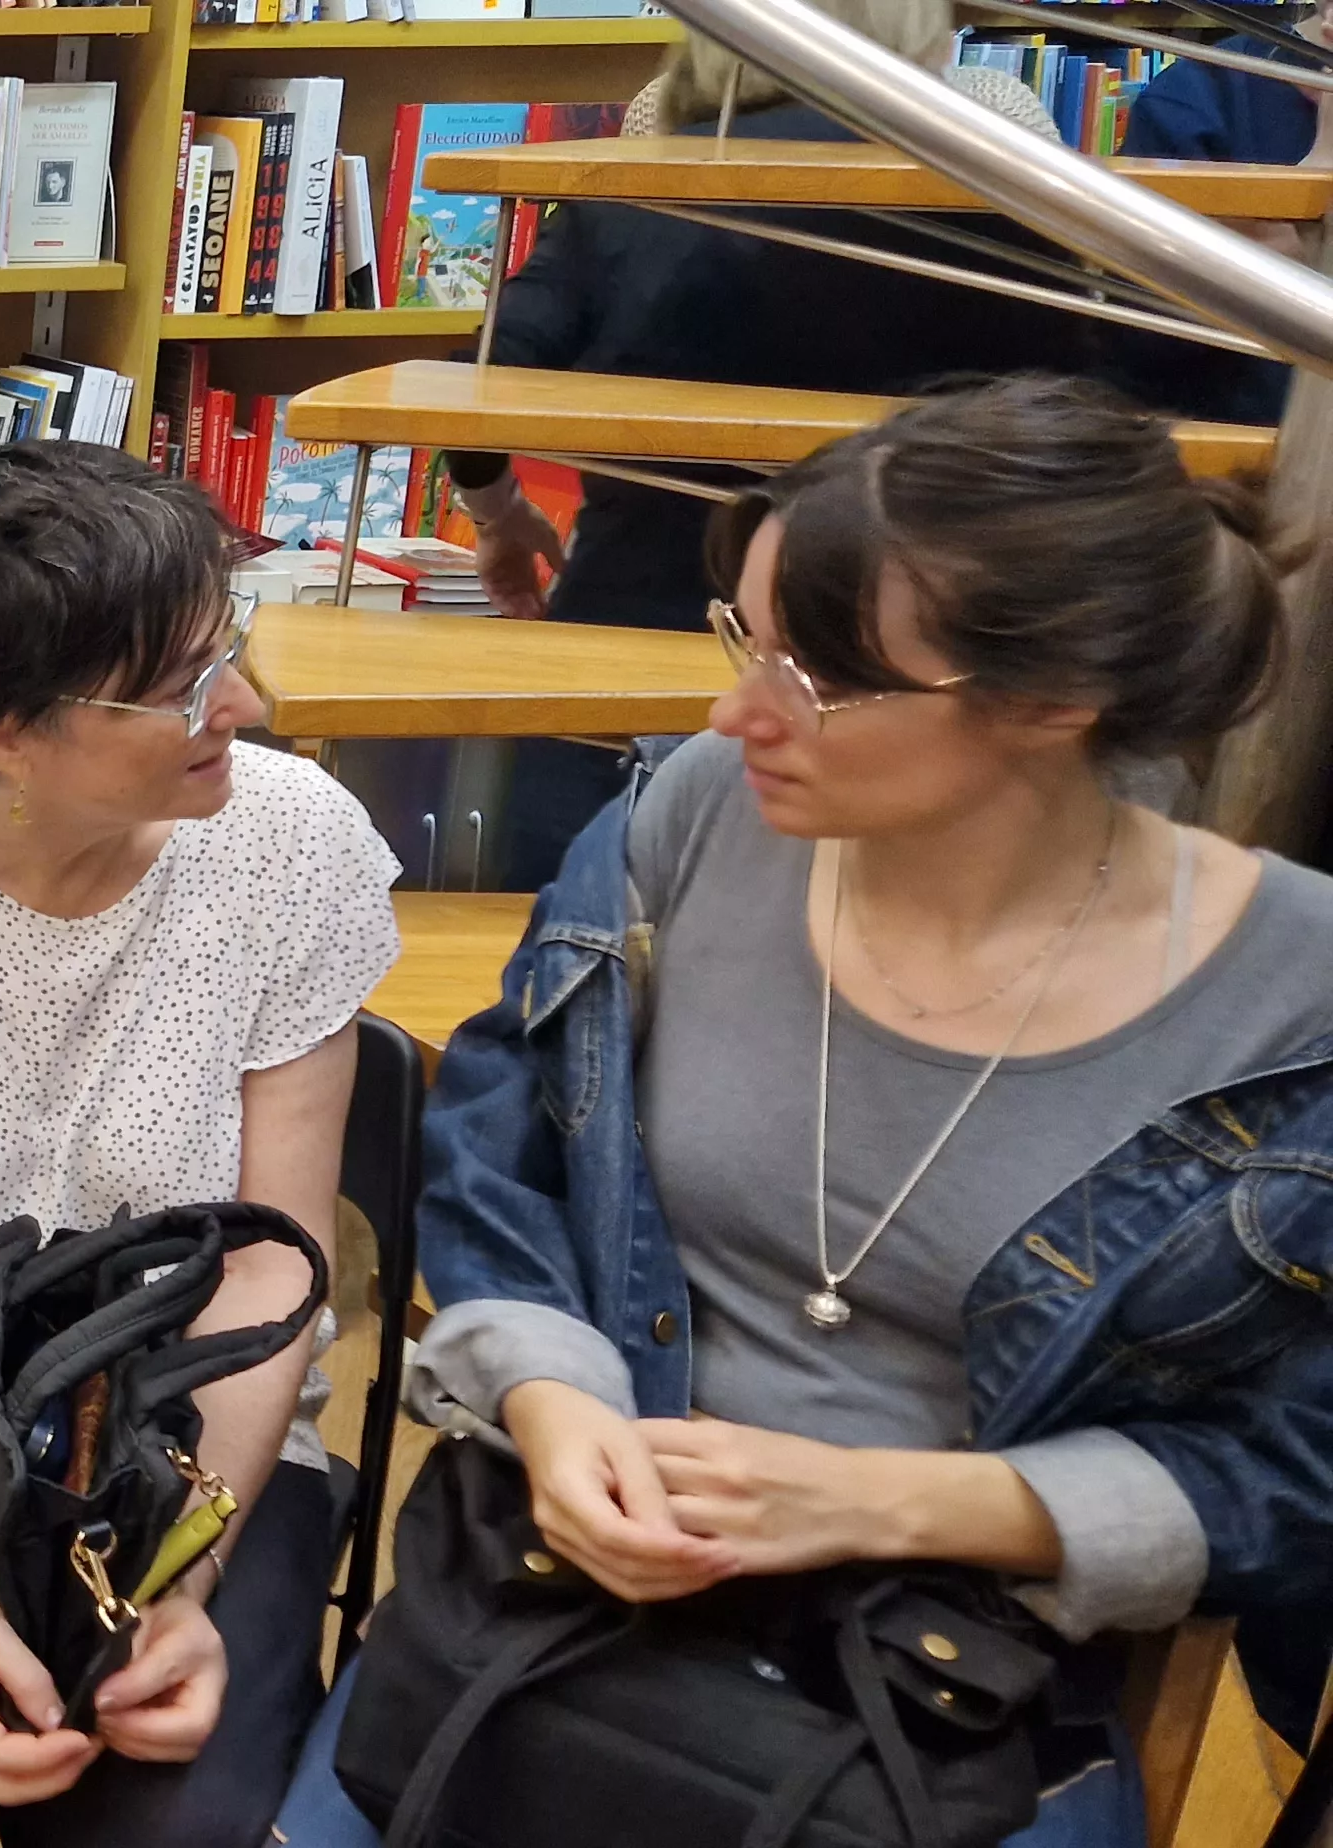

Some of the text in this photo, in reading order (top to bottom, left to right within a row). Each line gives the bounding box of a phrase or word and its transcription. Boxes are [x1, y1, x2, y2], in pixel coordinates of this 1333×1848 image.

[176, 122, 191, 190] ARTUR HERAS
[425, 132, 520, 145] ElectriCIUDAD
[182, 154, 207, 292] CALATAYUD TURIA
[201, 175, 230, 289] SEOANE
[249, 163, 271, 284] 1984
[264, 162, 286, 282] 1984
[189, 406, 204, 462] ROMANCE
